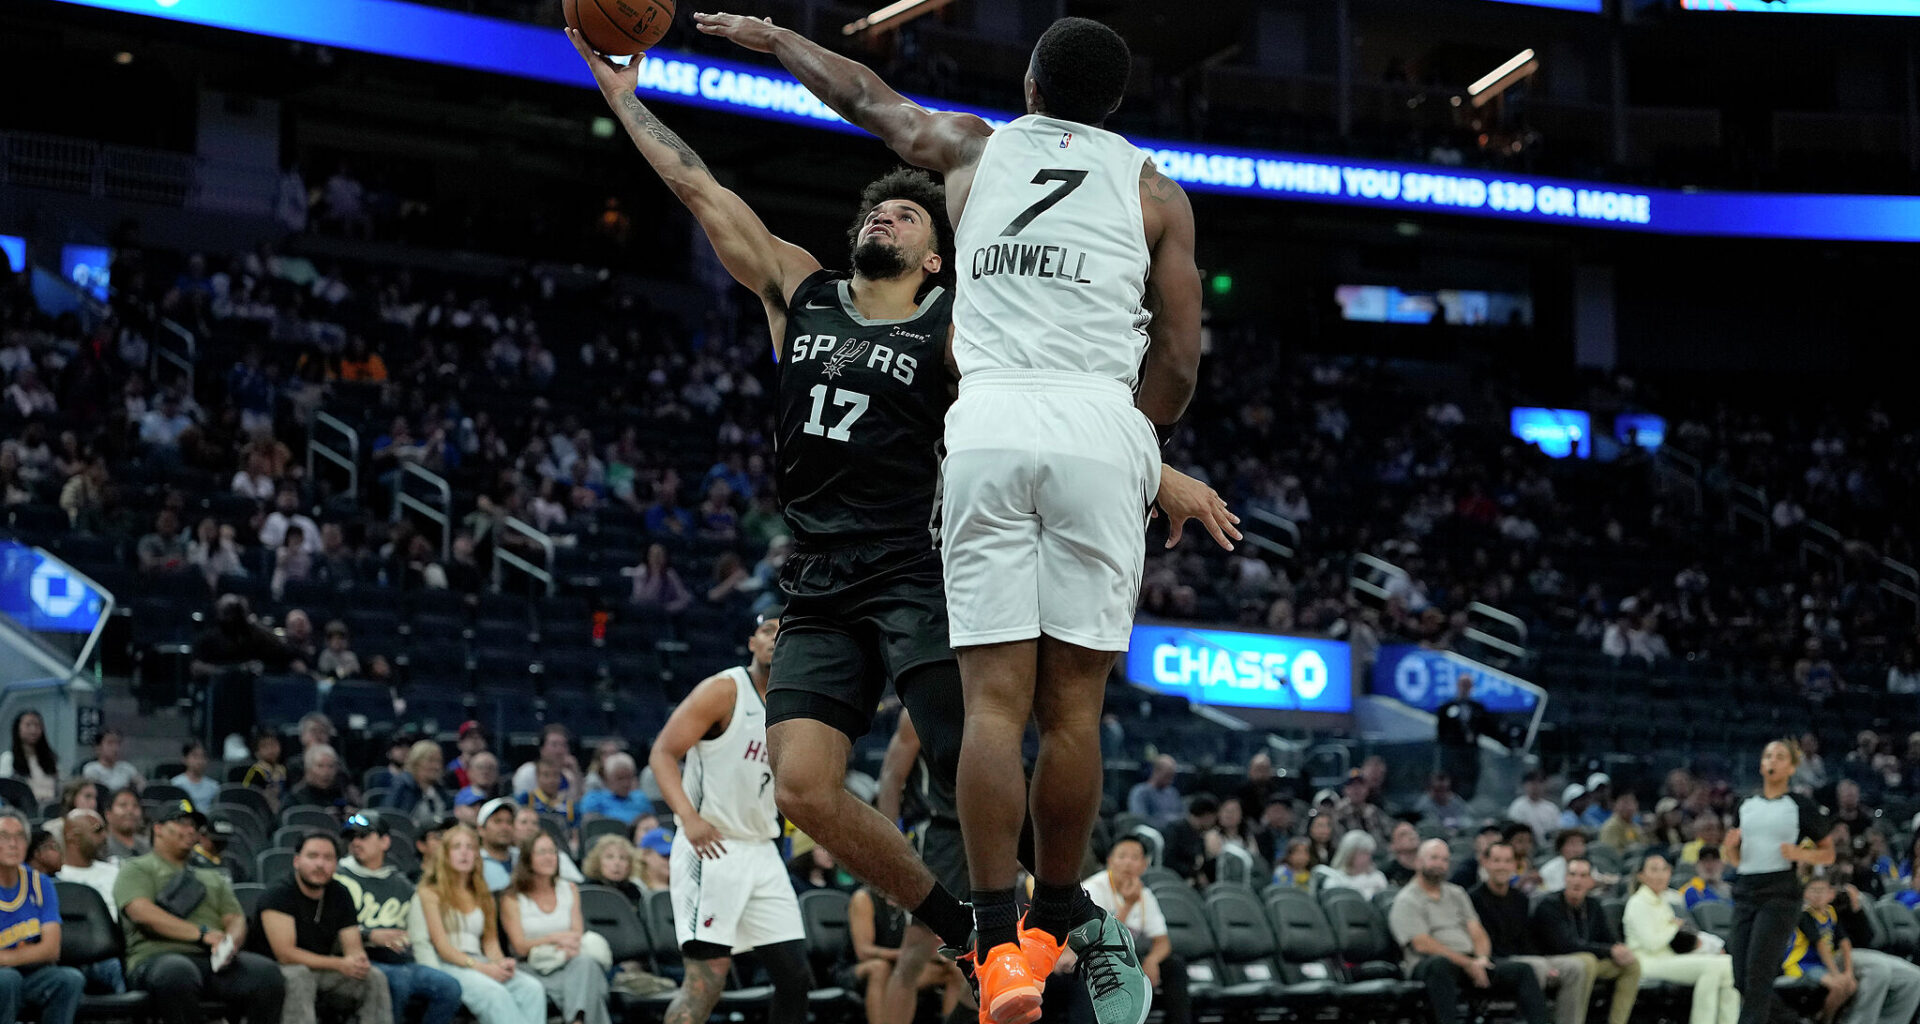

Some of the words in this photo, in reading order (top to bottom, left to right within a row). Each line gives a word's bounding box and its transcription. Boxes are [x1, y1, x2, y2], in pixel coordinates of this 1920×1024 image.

[638, 55, 699, 96] ASE
[999, 168, 1089, 237] 7
[1256, 159, 1341, 195] WHEN
[1342, 167, 1400, 200] YOU
[1401, 172, 1487, 208] SPEND
[1487, 180, 1535, 212] $30
[1536, 185, 1575, 217] OR
[1576, 189, 1651, 224] MORE
[972, 243, 1091, 284] CONWELL
[803, 383, 870, 442] 17
[1153, 643, 1287, 690] CHASE
